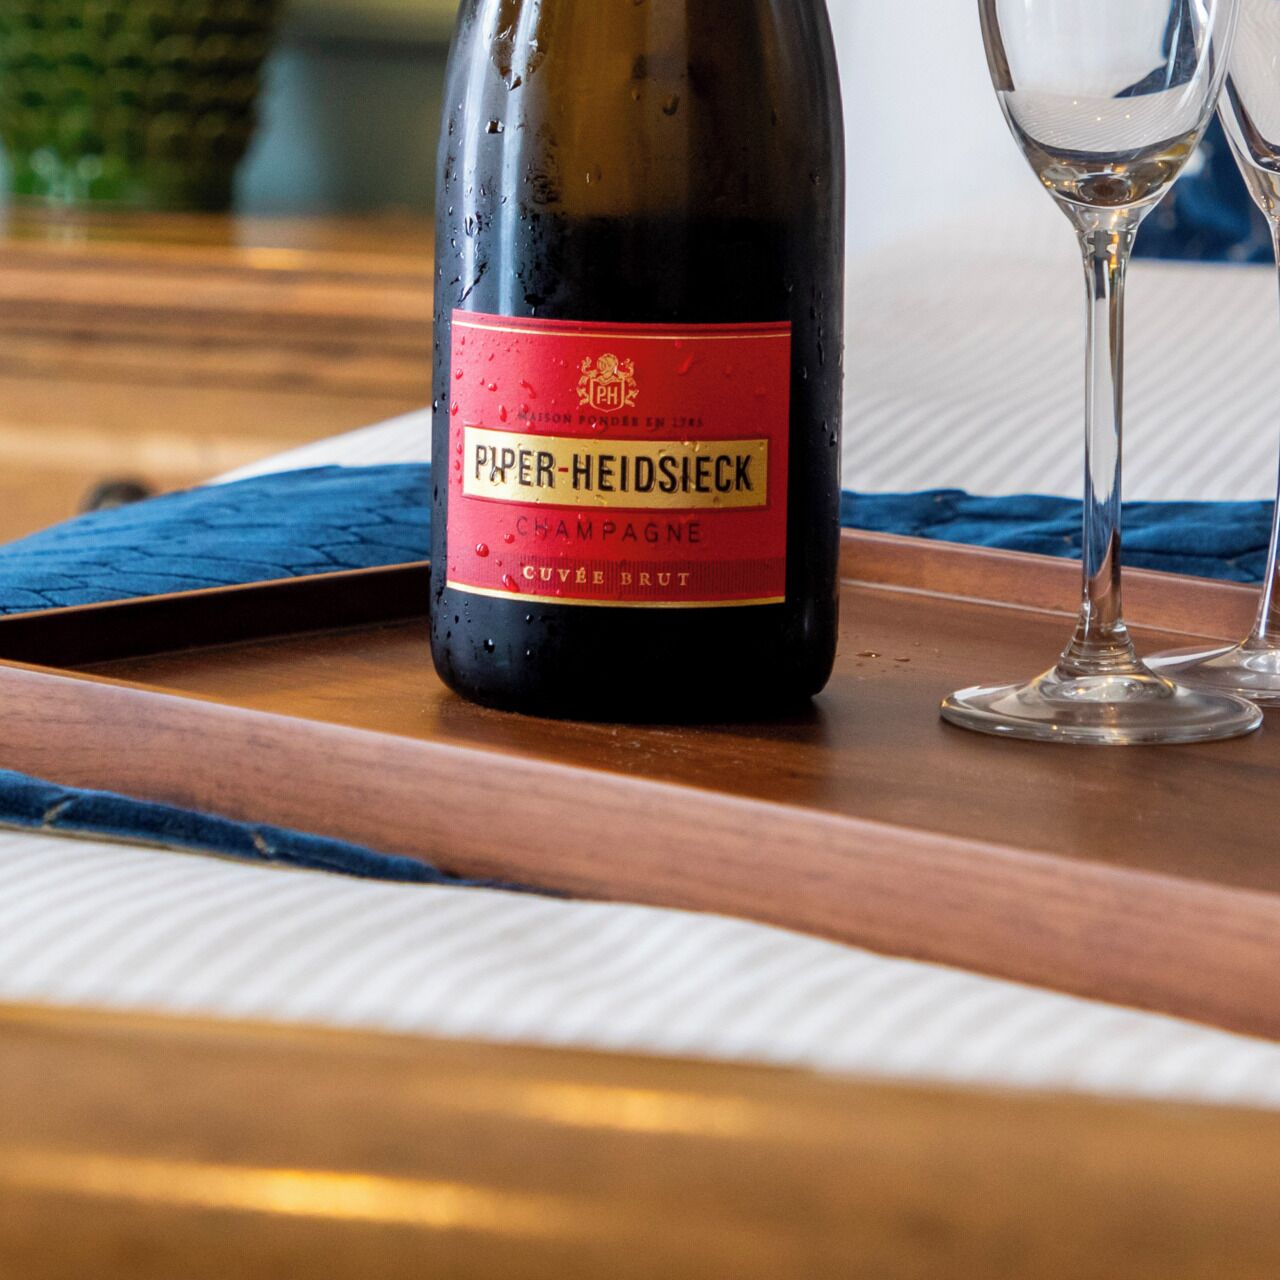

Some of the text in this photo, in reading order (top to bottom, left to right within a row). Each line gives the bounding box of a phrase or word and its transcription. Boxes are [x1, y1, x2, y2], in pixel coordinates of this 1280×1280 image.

[474, 444, 754, 494] PIPER-HEIDSIECK
[515, 515, 703, 544] CHAMPAGNE
[522, 565, 691, 587] CUVÉE BRUT
